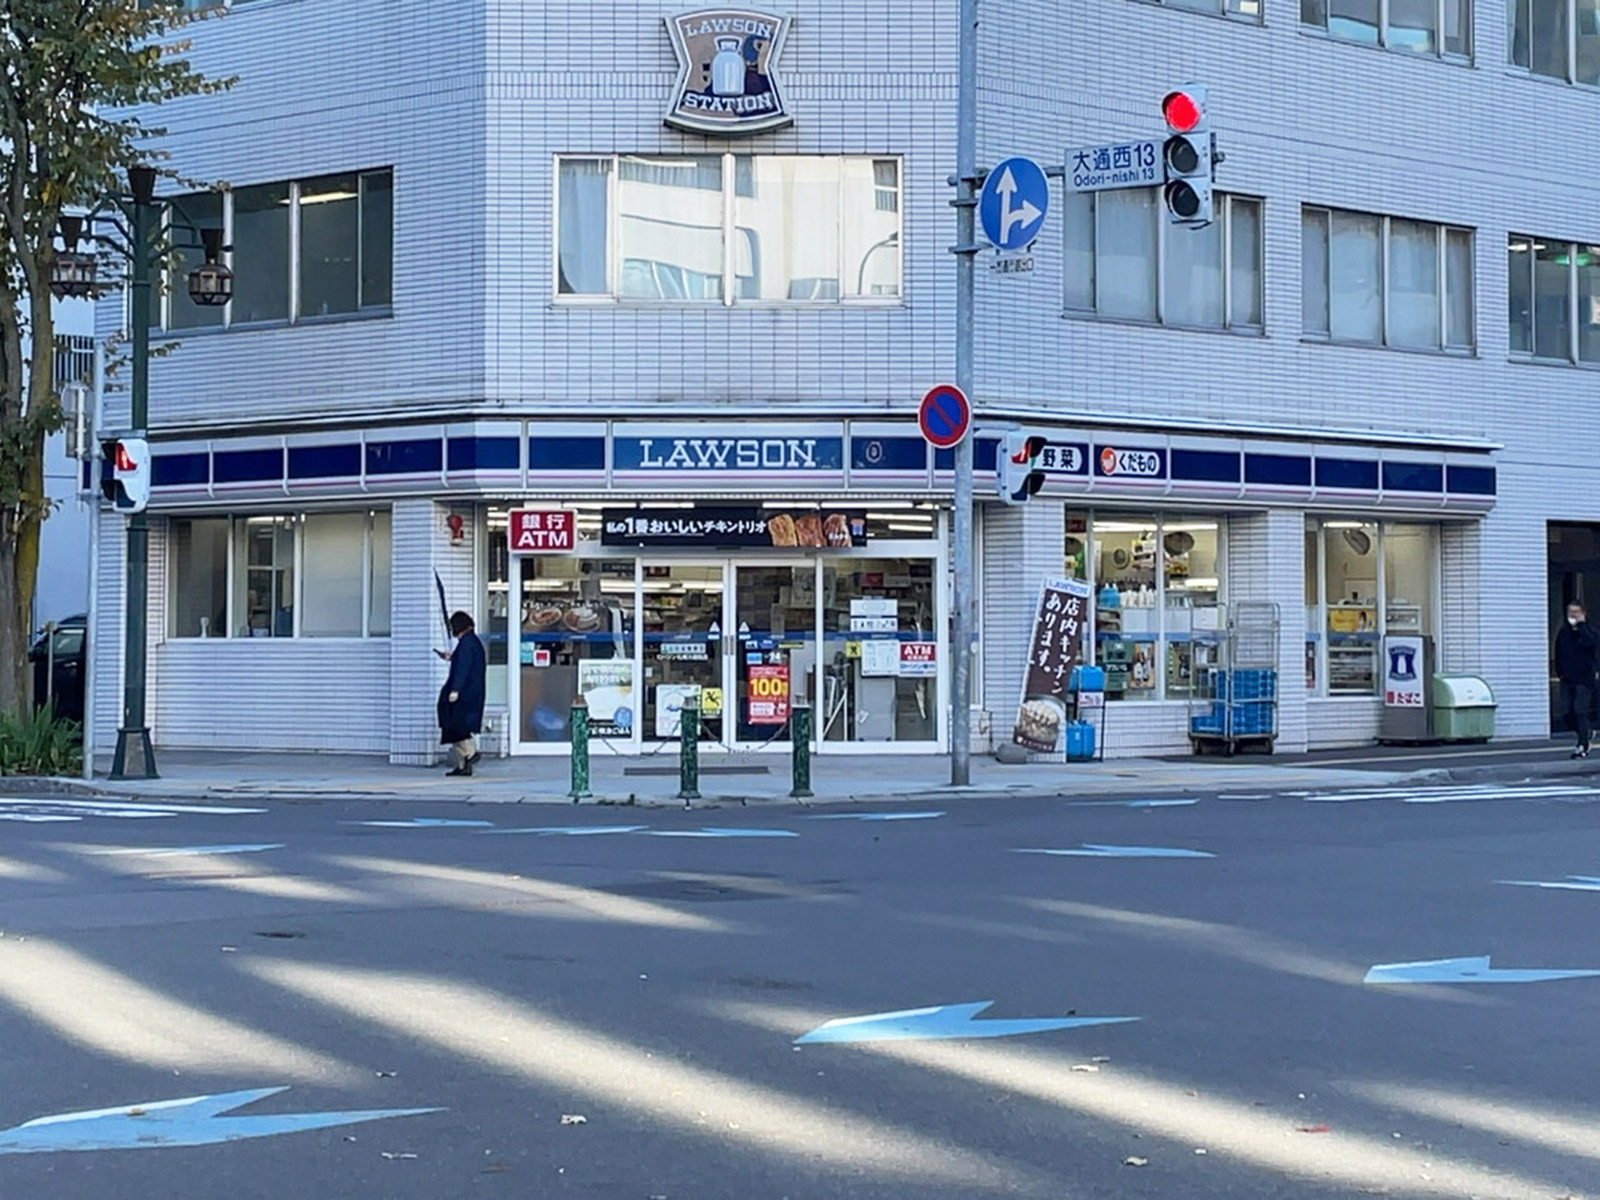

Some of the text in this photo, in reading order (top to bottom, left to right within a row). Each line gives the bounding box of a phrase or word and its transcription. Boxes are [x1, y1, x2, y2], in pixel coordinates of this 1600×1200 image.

[684, 18, 773, 39] LAWSON
[684, 92, 774, 112] STATION
[1073, 143, 1156, 173] 大通西13
[1074, 168, 1155, 187] Odori-nishi 13
[639, 440, 817, 468] LAWSON
[1042, 448, 1074, 469] 野菜
[1118, 453, 1157, 472] くだもの
[521, 514, 566, 530] 銀行
[518, 531, 568, 547] ATM
[904, 645, 932, 655] ATM
[1052, 598, 1080, 694] 店内キッチン
